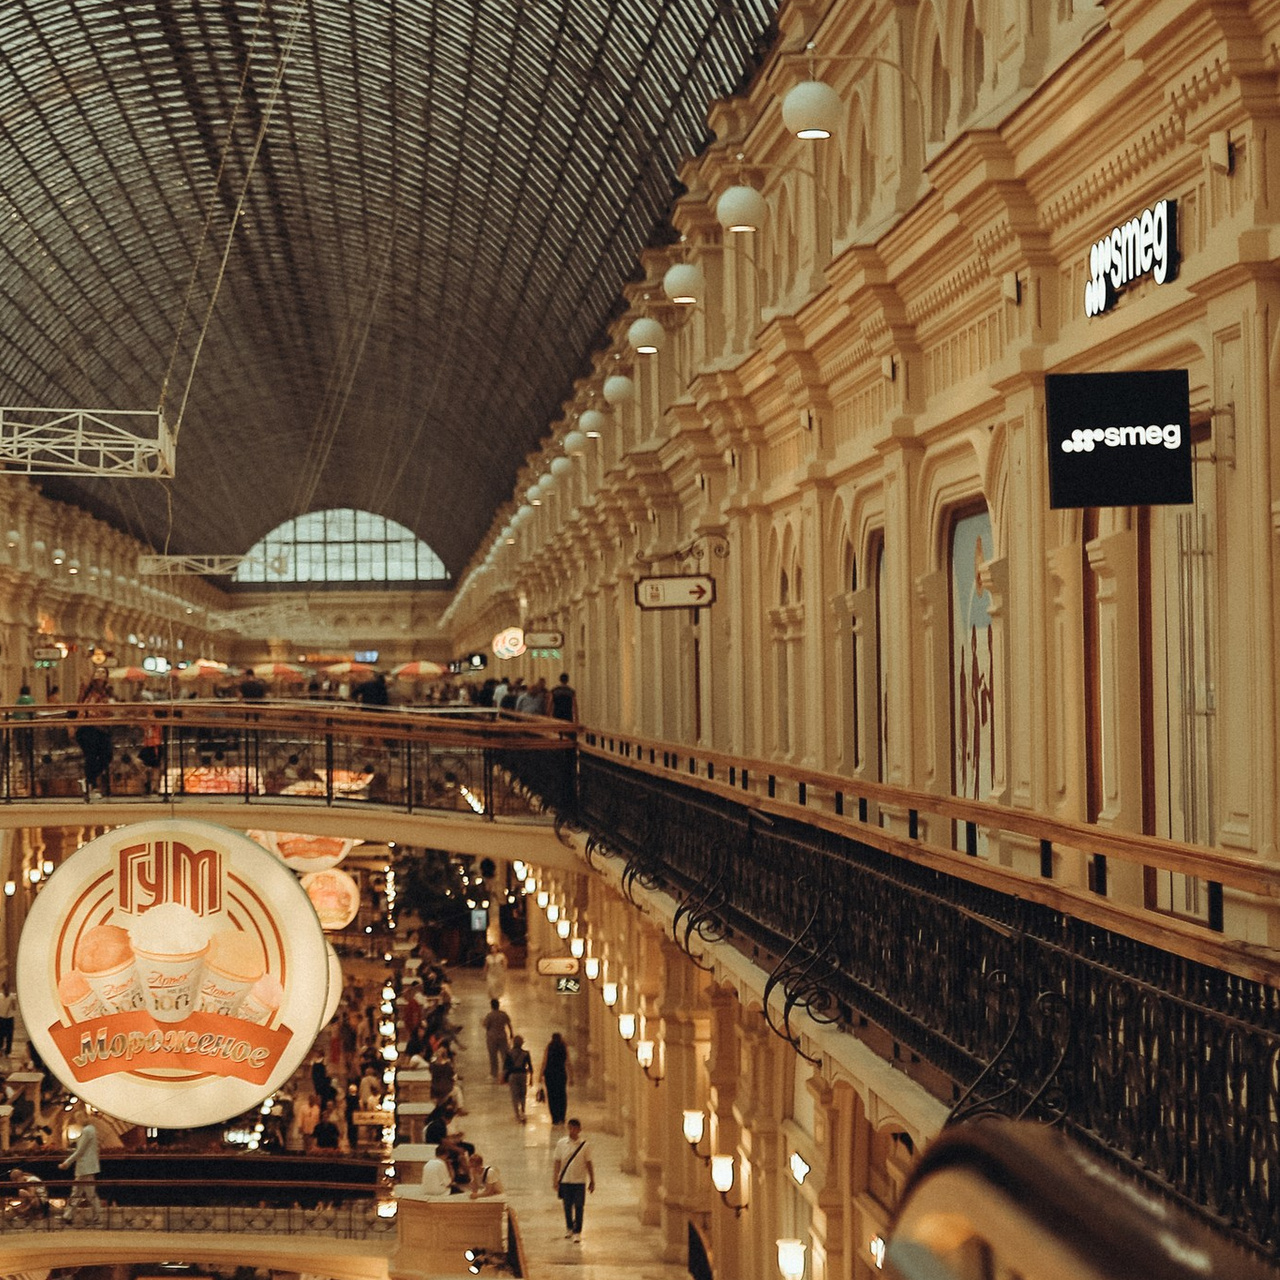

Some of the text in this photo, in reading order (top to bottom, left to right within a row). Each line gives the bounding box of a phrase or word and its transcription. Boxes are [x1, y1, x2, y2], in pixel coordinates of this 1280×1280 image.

[1110, 200, 1168, 289] smeg
[1104, 423, 1182, 450] smeg
[119, 841, 222, 917] ГУМ
[72, 1026, 271, 1068] Мороженое
